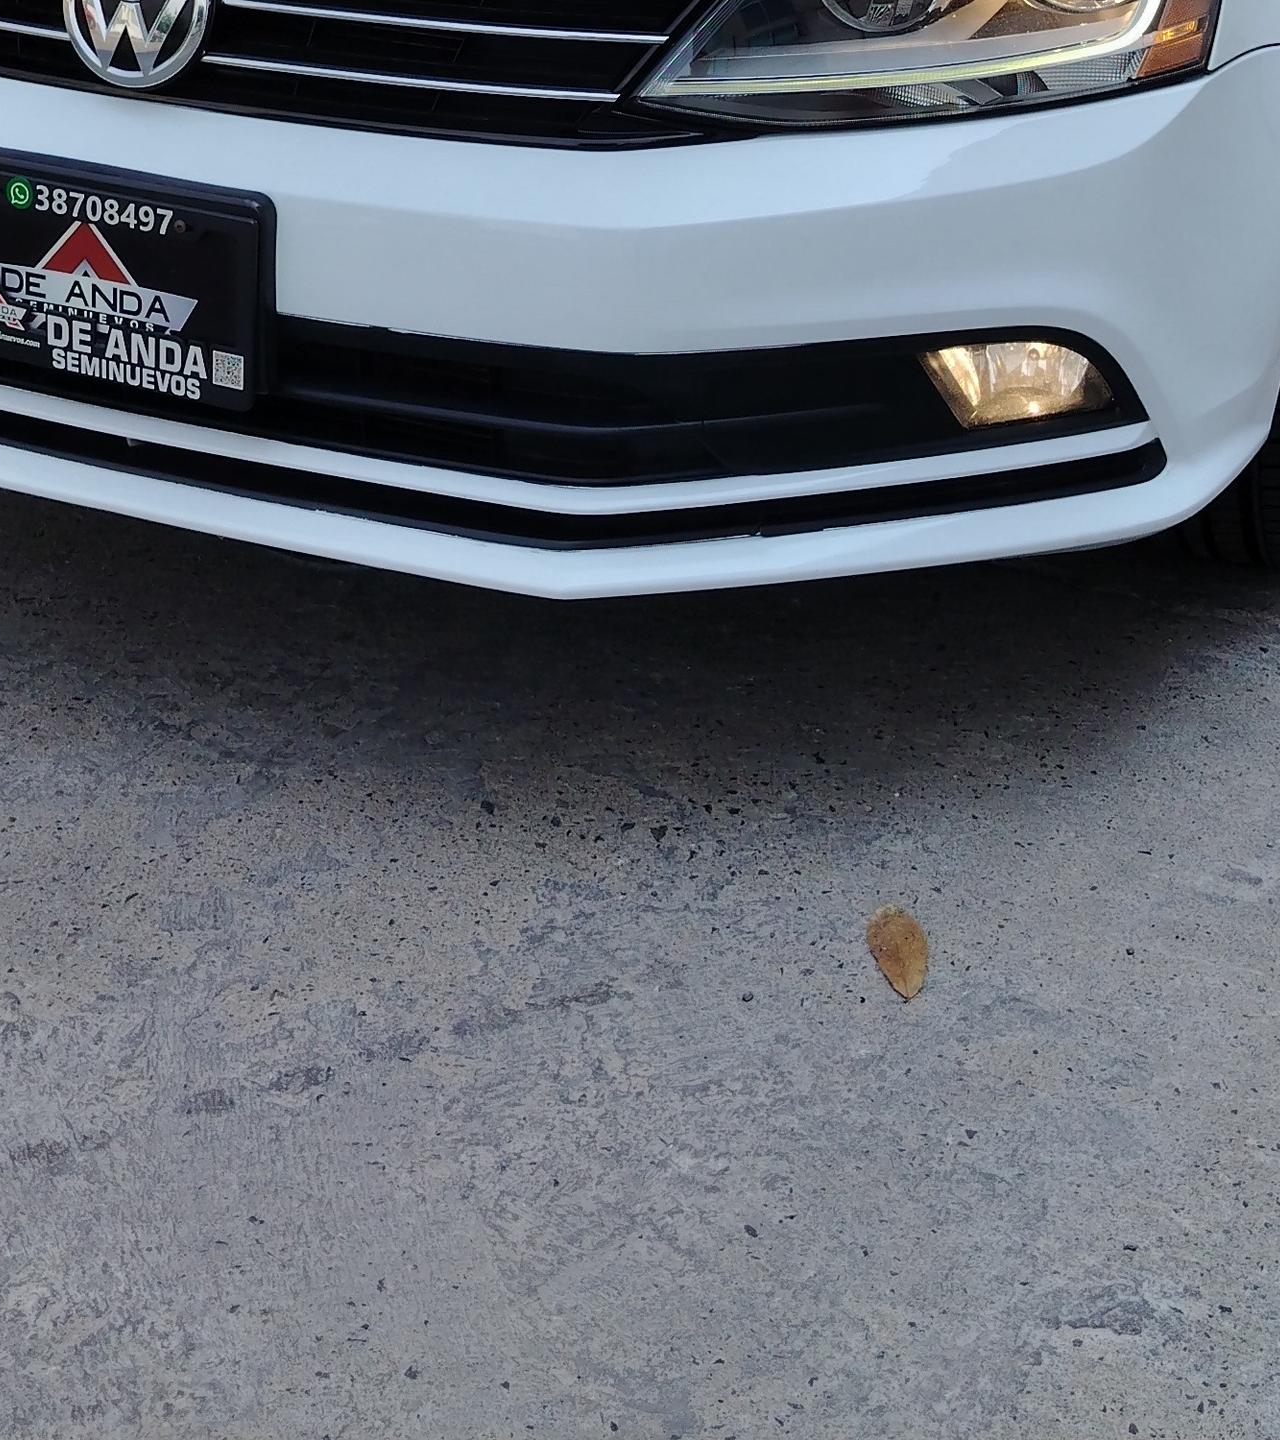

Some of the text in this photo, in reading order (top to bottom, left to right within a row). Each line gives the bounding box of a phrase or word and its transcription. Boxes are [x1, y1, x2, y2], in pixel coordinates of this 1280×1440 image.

[34, 184, 174, 235] 38708497
[0, 266, 47, 299] DE
[65, 277, 171, 323] ANDA
[46, 316, 208, 379] DE ANDA
[51, 347, 201, 401] SEMINUEVOS
